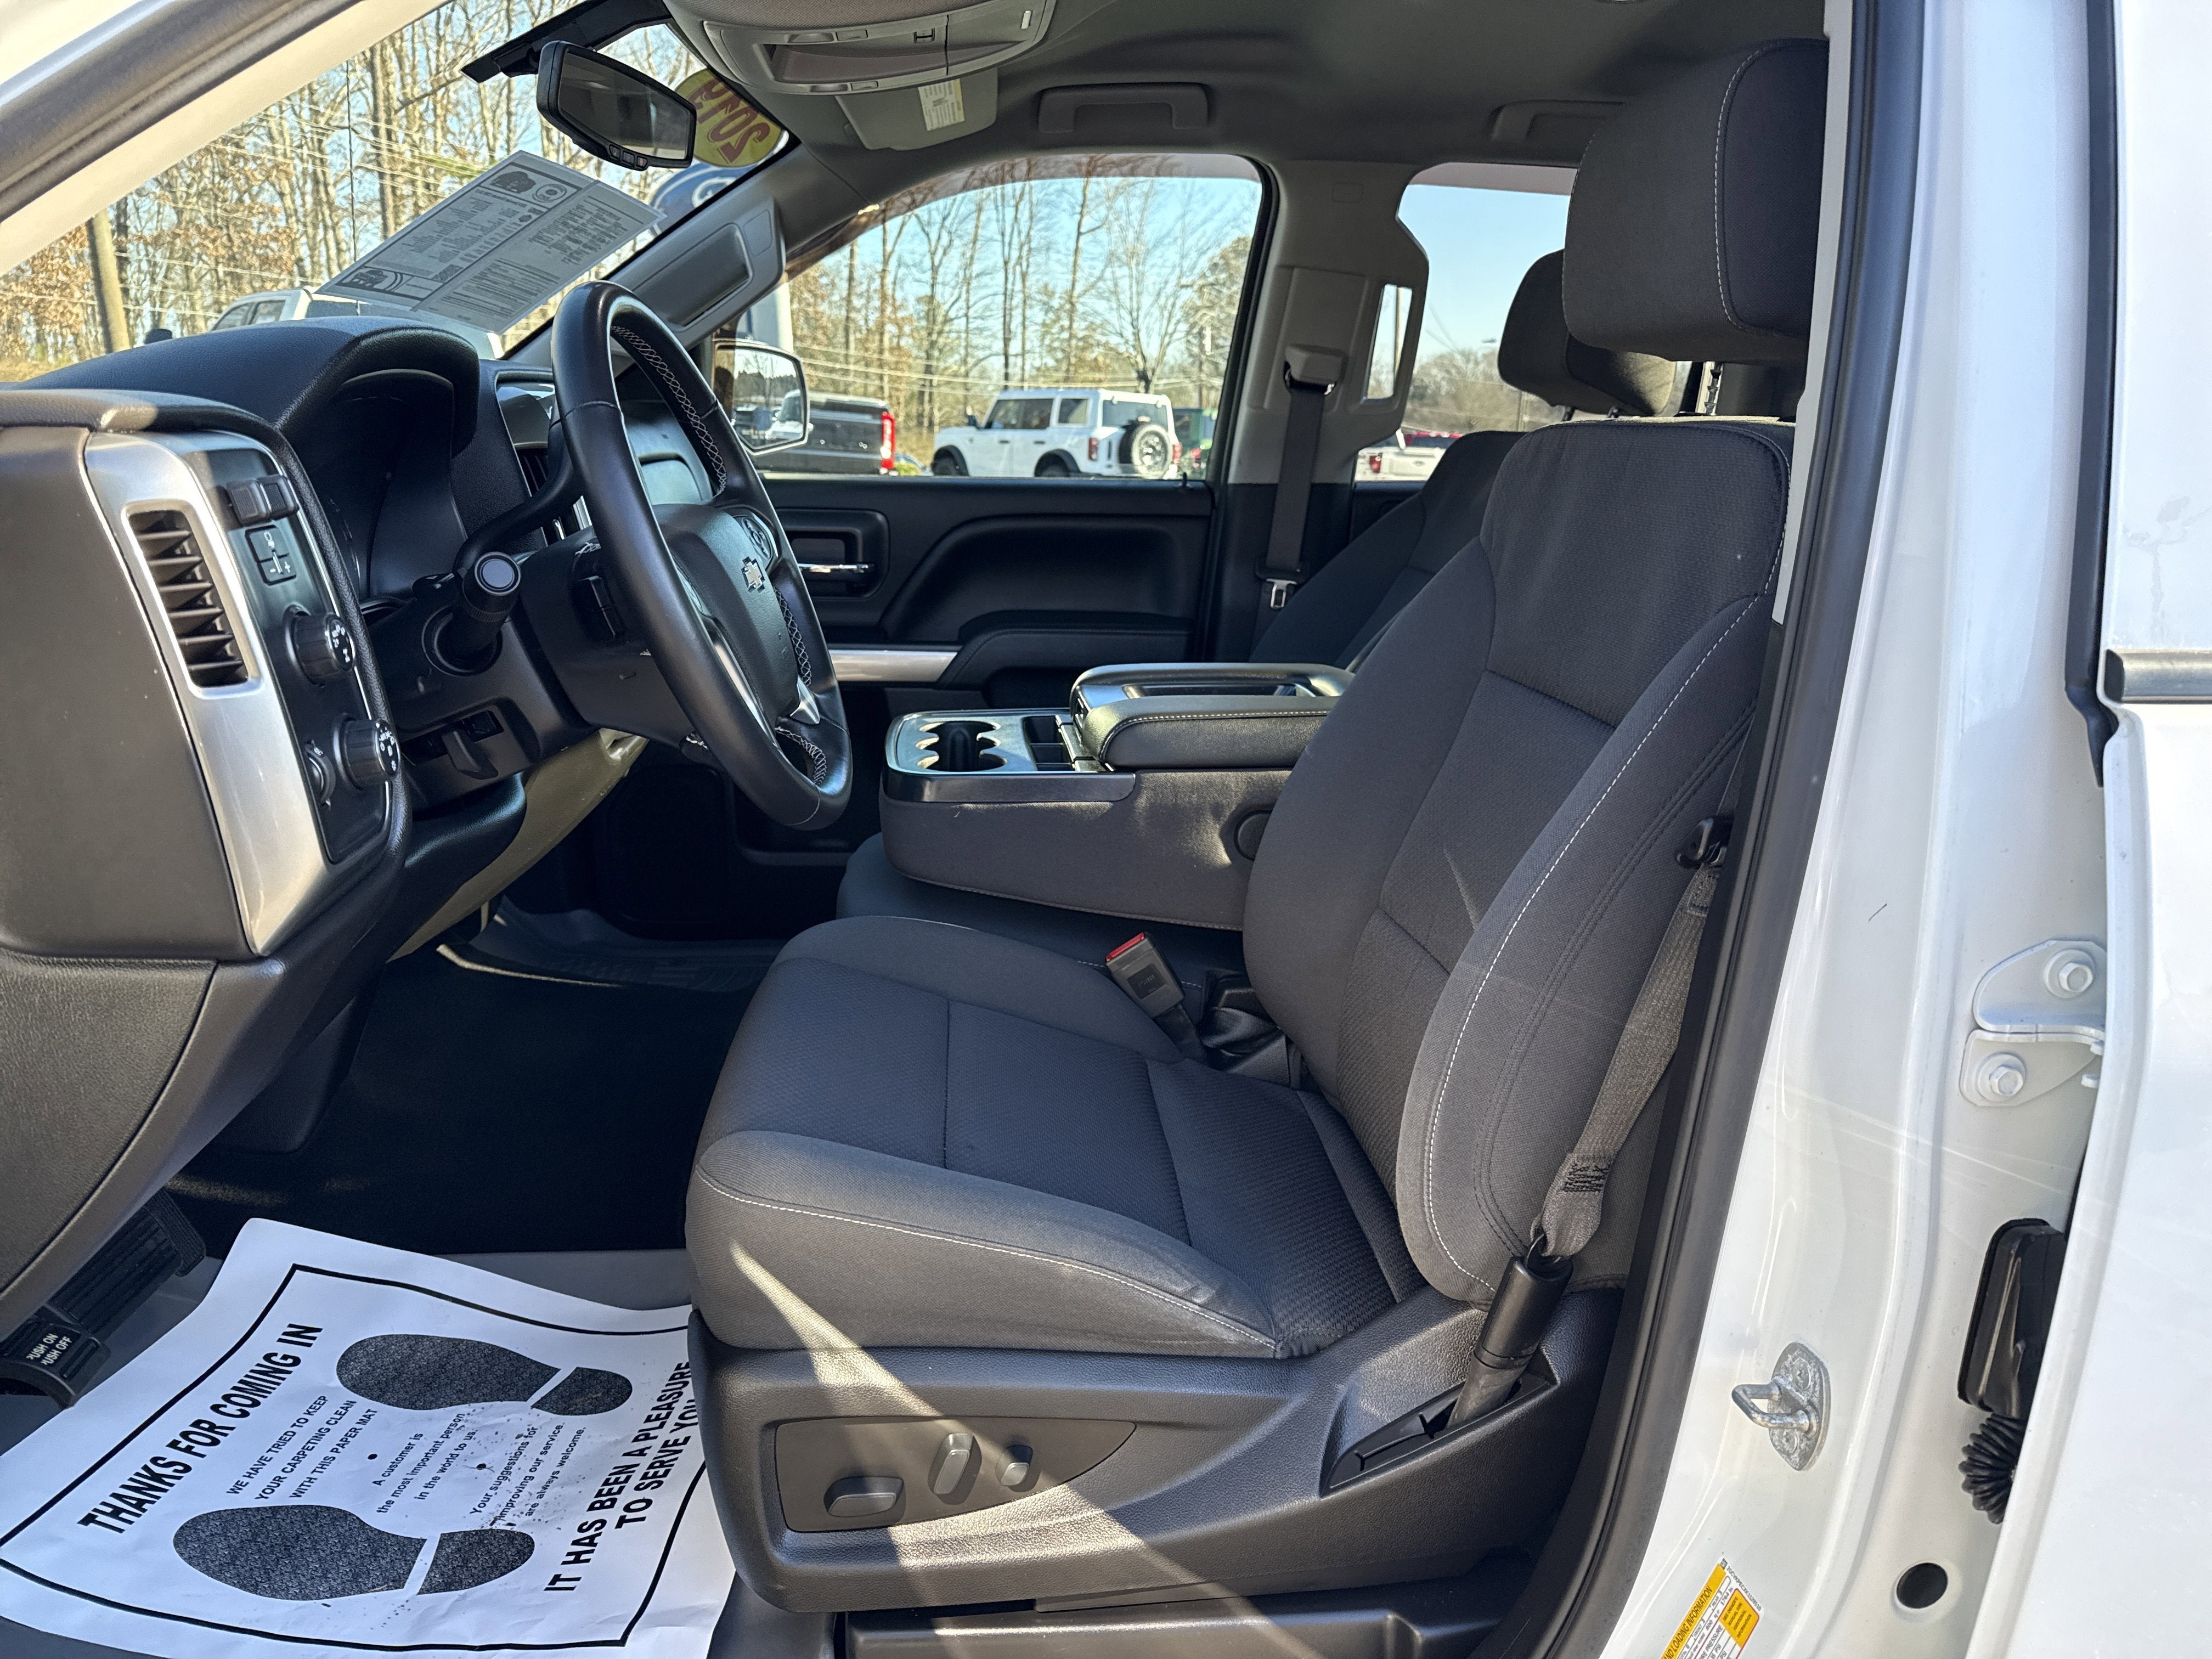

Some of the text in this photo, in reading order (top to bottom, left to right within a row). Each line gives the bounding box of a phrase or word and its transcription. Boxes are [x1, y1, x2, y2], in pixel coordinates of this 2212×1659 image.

[43, 1333, 59, 1344] ON
[55, 1336, 72, 1350] OFF
[77, 1323, 323, 1534] THANKS FOR COMING IN
[226, 1396, 329, 1494] WE HAVE TRIED TO KEEP
[254, 1400, 357, 1500] YOUR CARPETING CLEAN
[289, 1408, 377, 1498] WITH THIS PAPER MAT
[376, 1413, 466, 1514] the most important person
[381, 1442, 416, 1477] customer
[409, 1432, 424, 1441] is
[414, 1491, 430, 1500] in
[423, 1476, 441, 1489] the
[436, 1453, 460, 1474] world
[454, 1443, 467, 1451] to
[470, 1426, 538, 1514] Your suggestions for
[496, 1422, 566, 1521] improving our service.
[525, 1427, 586, 1516] are always welcome.
[543, 1362, 691, 1592] IT HAS BEEN A PLEASURE
[614, 1497, 653, 1530] TO
[634, 1435, 691, 1491] SERVE
[1663, 1585, 1713, 1659] ND LOADING INFORMATION
[1705, 1624, 1723, 1652] PRESSURE
